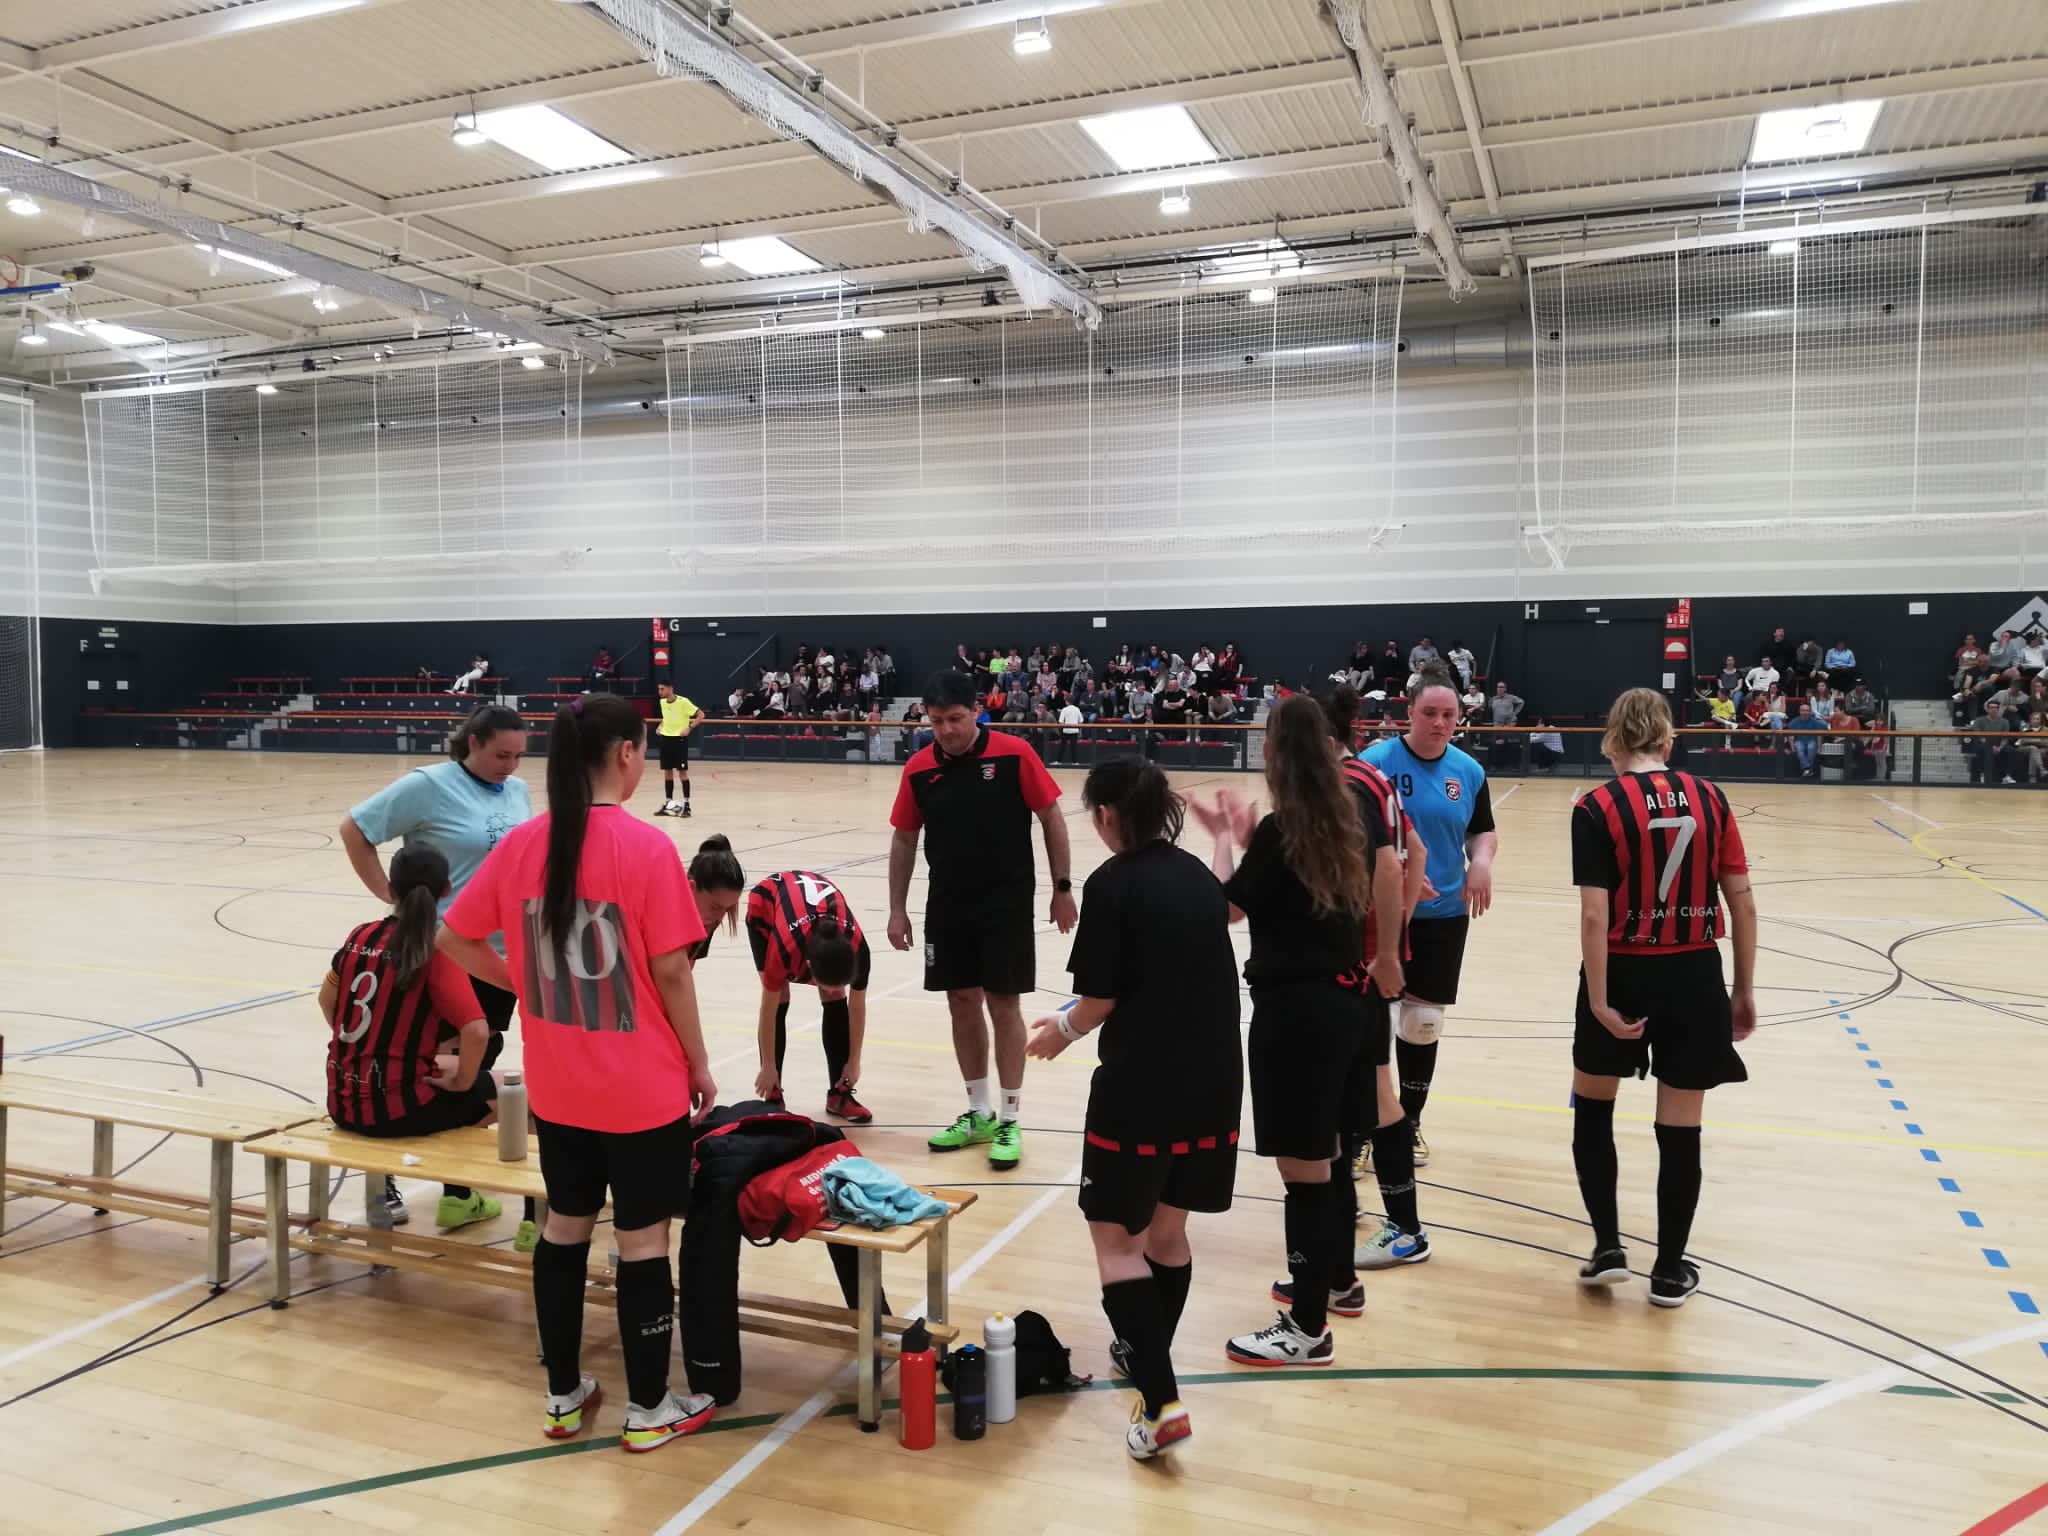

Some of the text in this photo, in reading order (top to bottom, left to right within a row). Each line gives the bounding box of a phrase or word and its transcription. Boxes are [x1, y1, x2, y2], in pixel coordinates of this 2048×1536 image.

[1524, 603, 1539, 620] H
[669, 619, 680, 632] G
[80, 639, 89, 652] F
[1646, 790, 1689, 811] ALBA
[1647, 815, 1698, 903] 7
[1650, 906, 1676, 920] SANT
[1680, 905, 1719, 918] CUGAT
[338, 970, 379, 1044] 3
